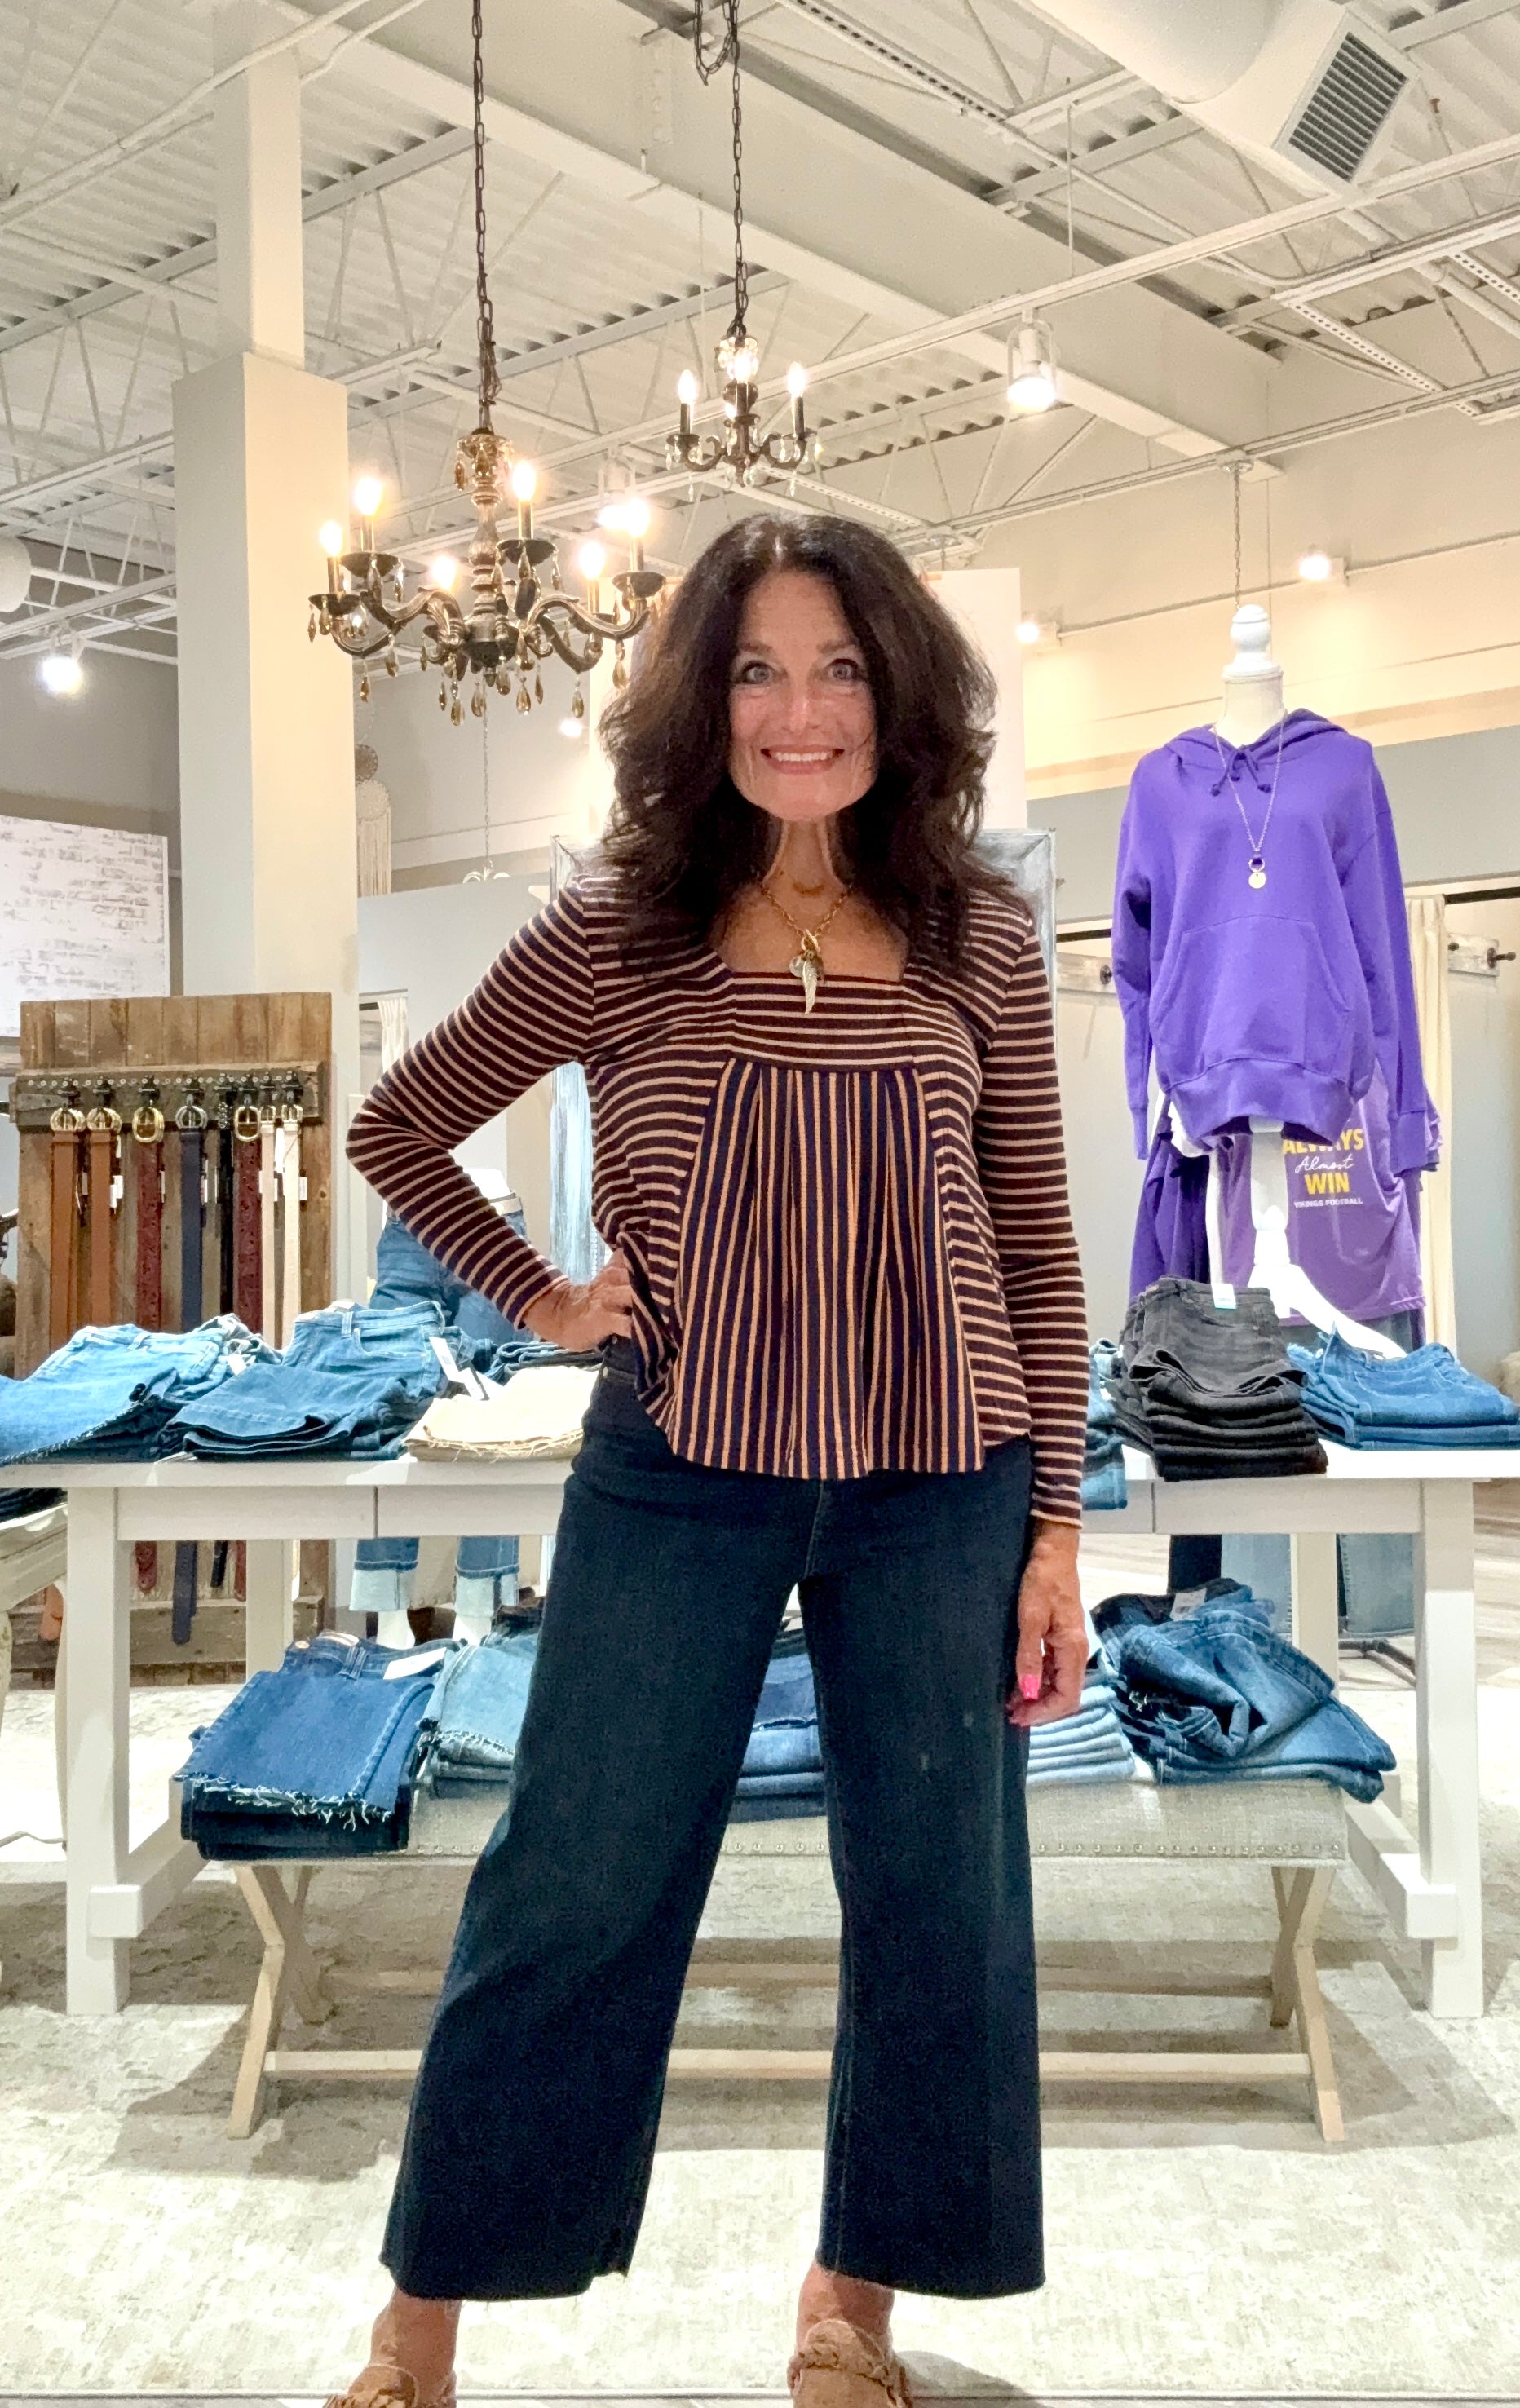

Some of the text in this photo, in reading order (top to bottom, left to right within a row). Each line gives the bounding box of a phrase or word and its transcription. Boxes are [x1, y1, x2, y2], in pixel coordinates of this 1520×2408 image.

[1295, 1153, 1354, 1173] Almost
[1304, 1172, 1350, 1195] WIN
[1294, 1198, 1363, 1208] VIKINGS FOOTBALL
